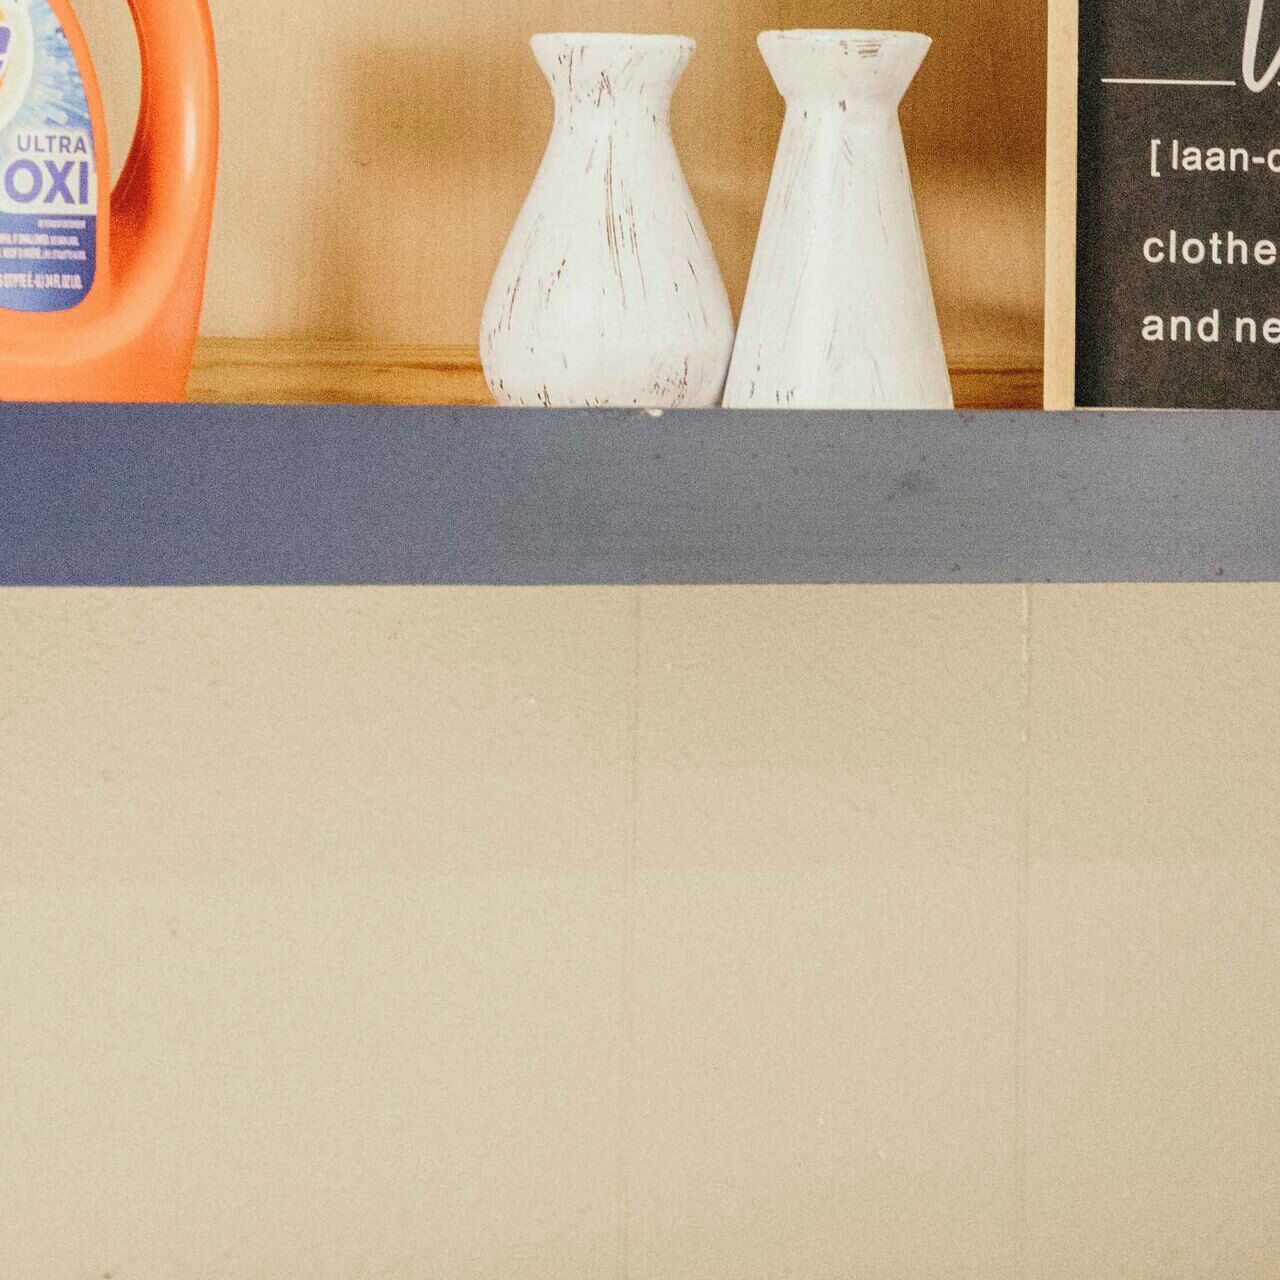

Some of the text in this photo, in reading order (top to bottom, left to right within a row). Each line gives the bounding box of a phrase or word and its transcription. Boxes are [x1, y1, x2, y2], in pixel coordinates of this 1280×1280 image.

[17, 134, 87, 155] ULTRA
[4, 158, 90, 205] OXI
[1141, 308, 1220, 344] and
